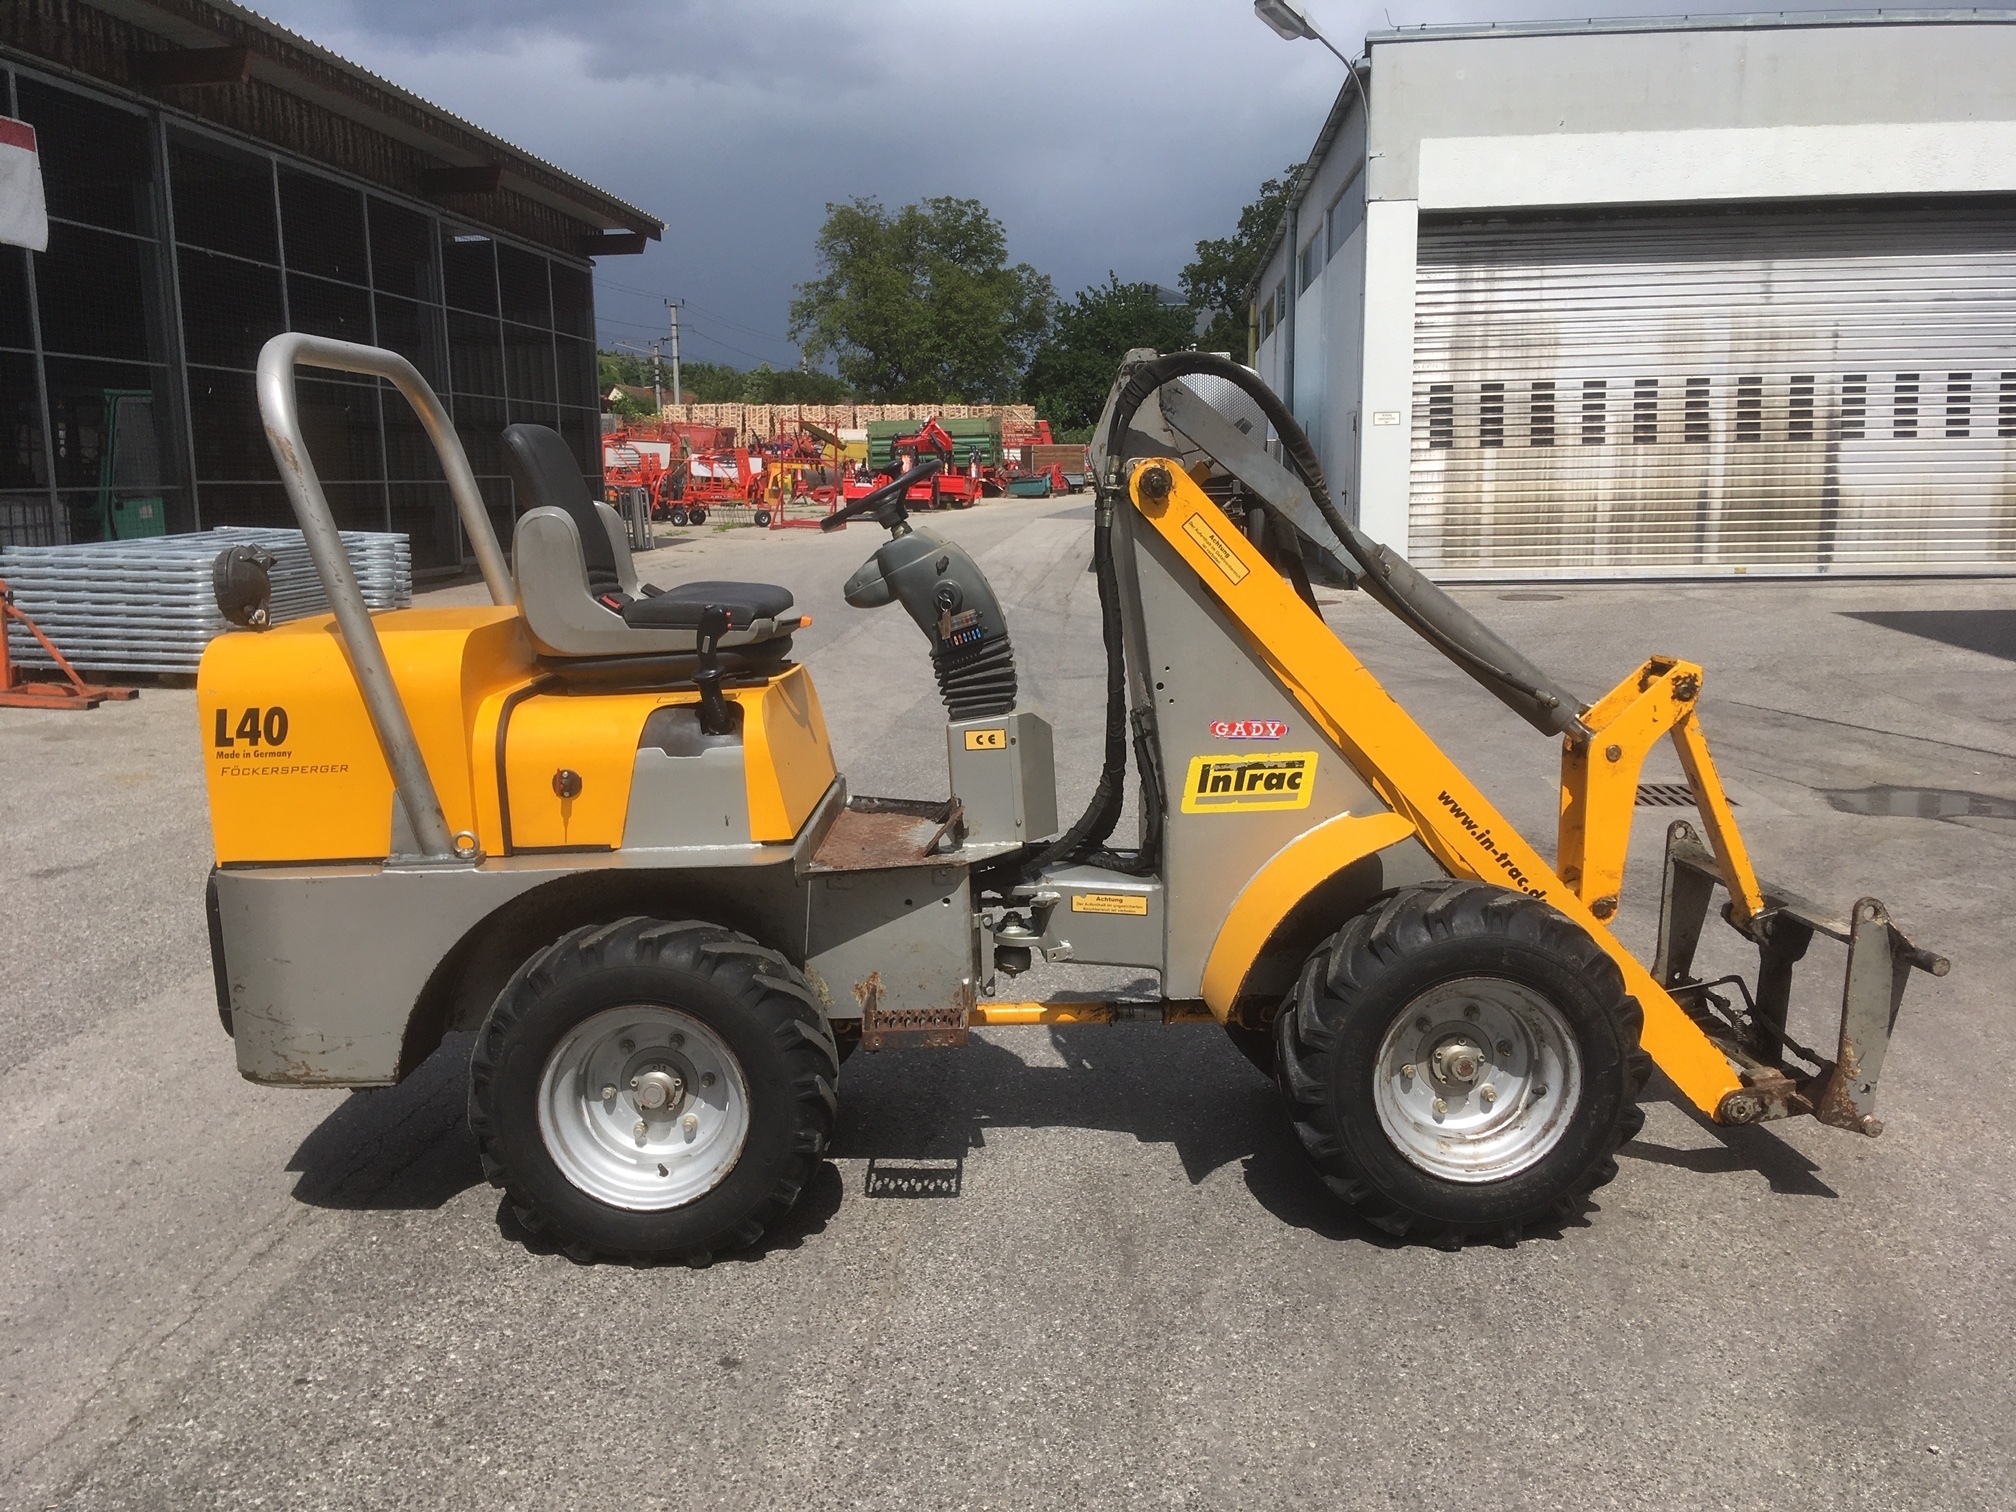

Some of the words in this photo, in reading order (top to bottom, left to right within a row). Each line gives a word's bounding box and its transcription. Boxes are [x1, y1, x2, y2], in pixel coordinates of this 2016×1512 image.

[1209, 534, 1230, 558] Achtung
[215, 706, 288, 747] L40
[1215, 722, 1280, 736] GADY
[976, 734, 995, 745] CE
[216, 750, 240, 759] Made
[243, 750, 250, 758] in
[253, 750, 292, 759] Germany
[221, 764, 349, 776] FÖCKERSPERGER
[1438, 790, 1548, 903] www.in-trac.d
